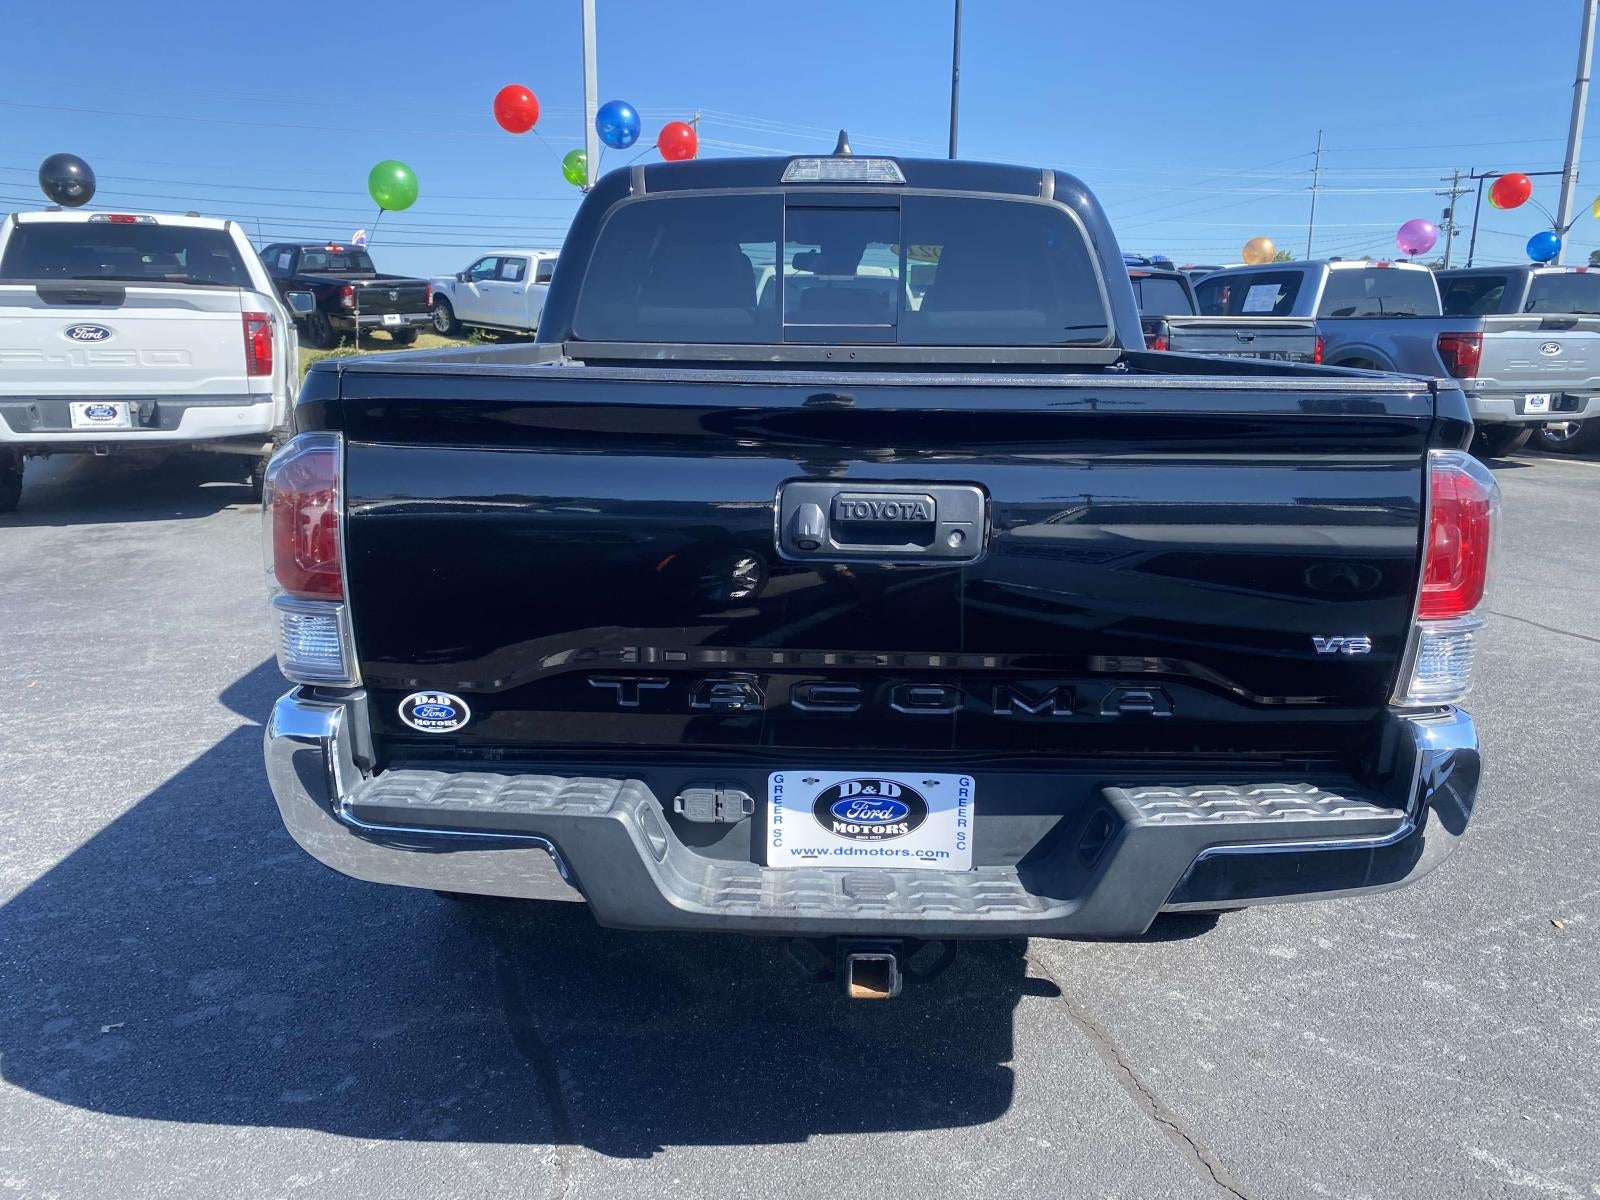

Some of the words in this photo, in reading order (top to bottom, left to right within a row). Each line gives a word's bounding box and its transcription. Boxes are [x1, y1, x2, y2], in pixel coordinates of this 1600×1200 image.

[71, 324, 104, 340] Ford
[840, 500, 929, 521] TOYOTA
[1311, 635, 1372, 655] V6
[414, 694, 451, 706] D&D
[586, 674, 1175, 717] TACOMA
[420, 705, 447, 718] Ford
[413, 718, 458, 727] MOTORS
[838, 781, 902, 798] D&D
[773, 774, 784, 825] GREER
[957, 777, 970, 828] GREER
[845, 799, 894, 820] Ford
[832, 821, 909, 834] MOTORS
[773, 828, 783, 847] SC
[956, 831, 967, 850] SC
[790, 845, 951, 859] www.ddmotors.com
